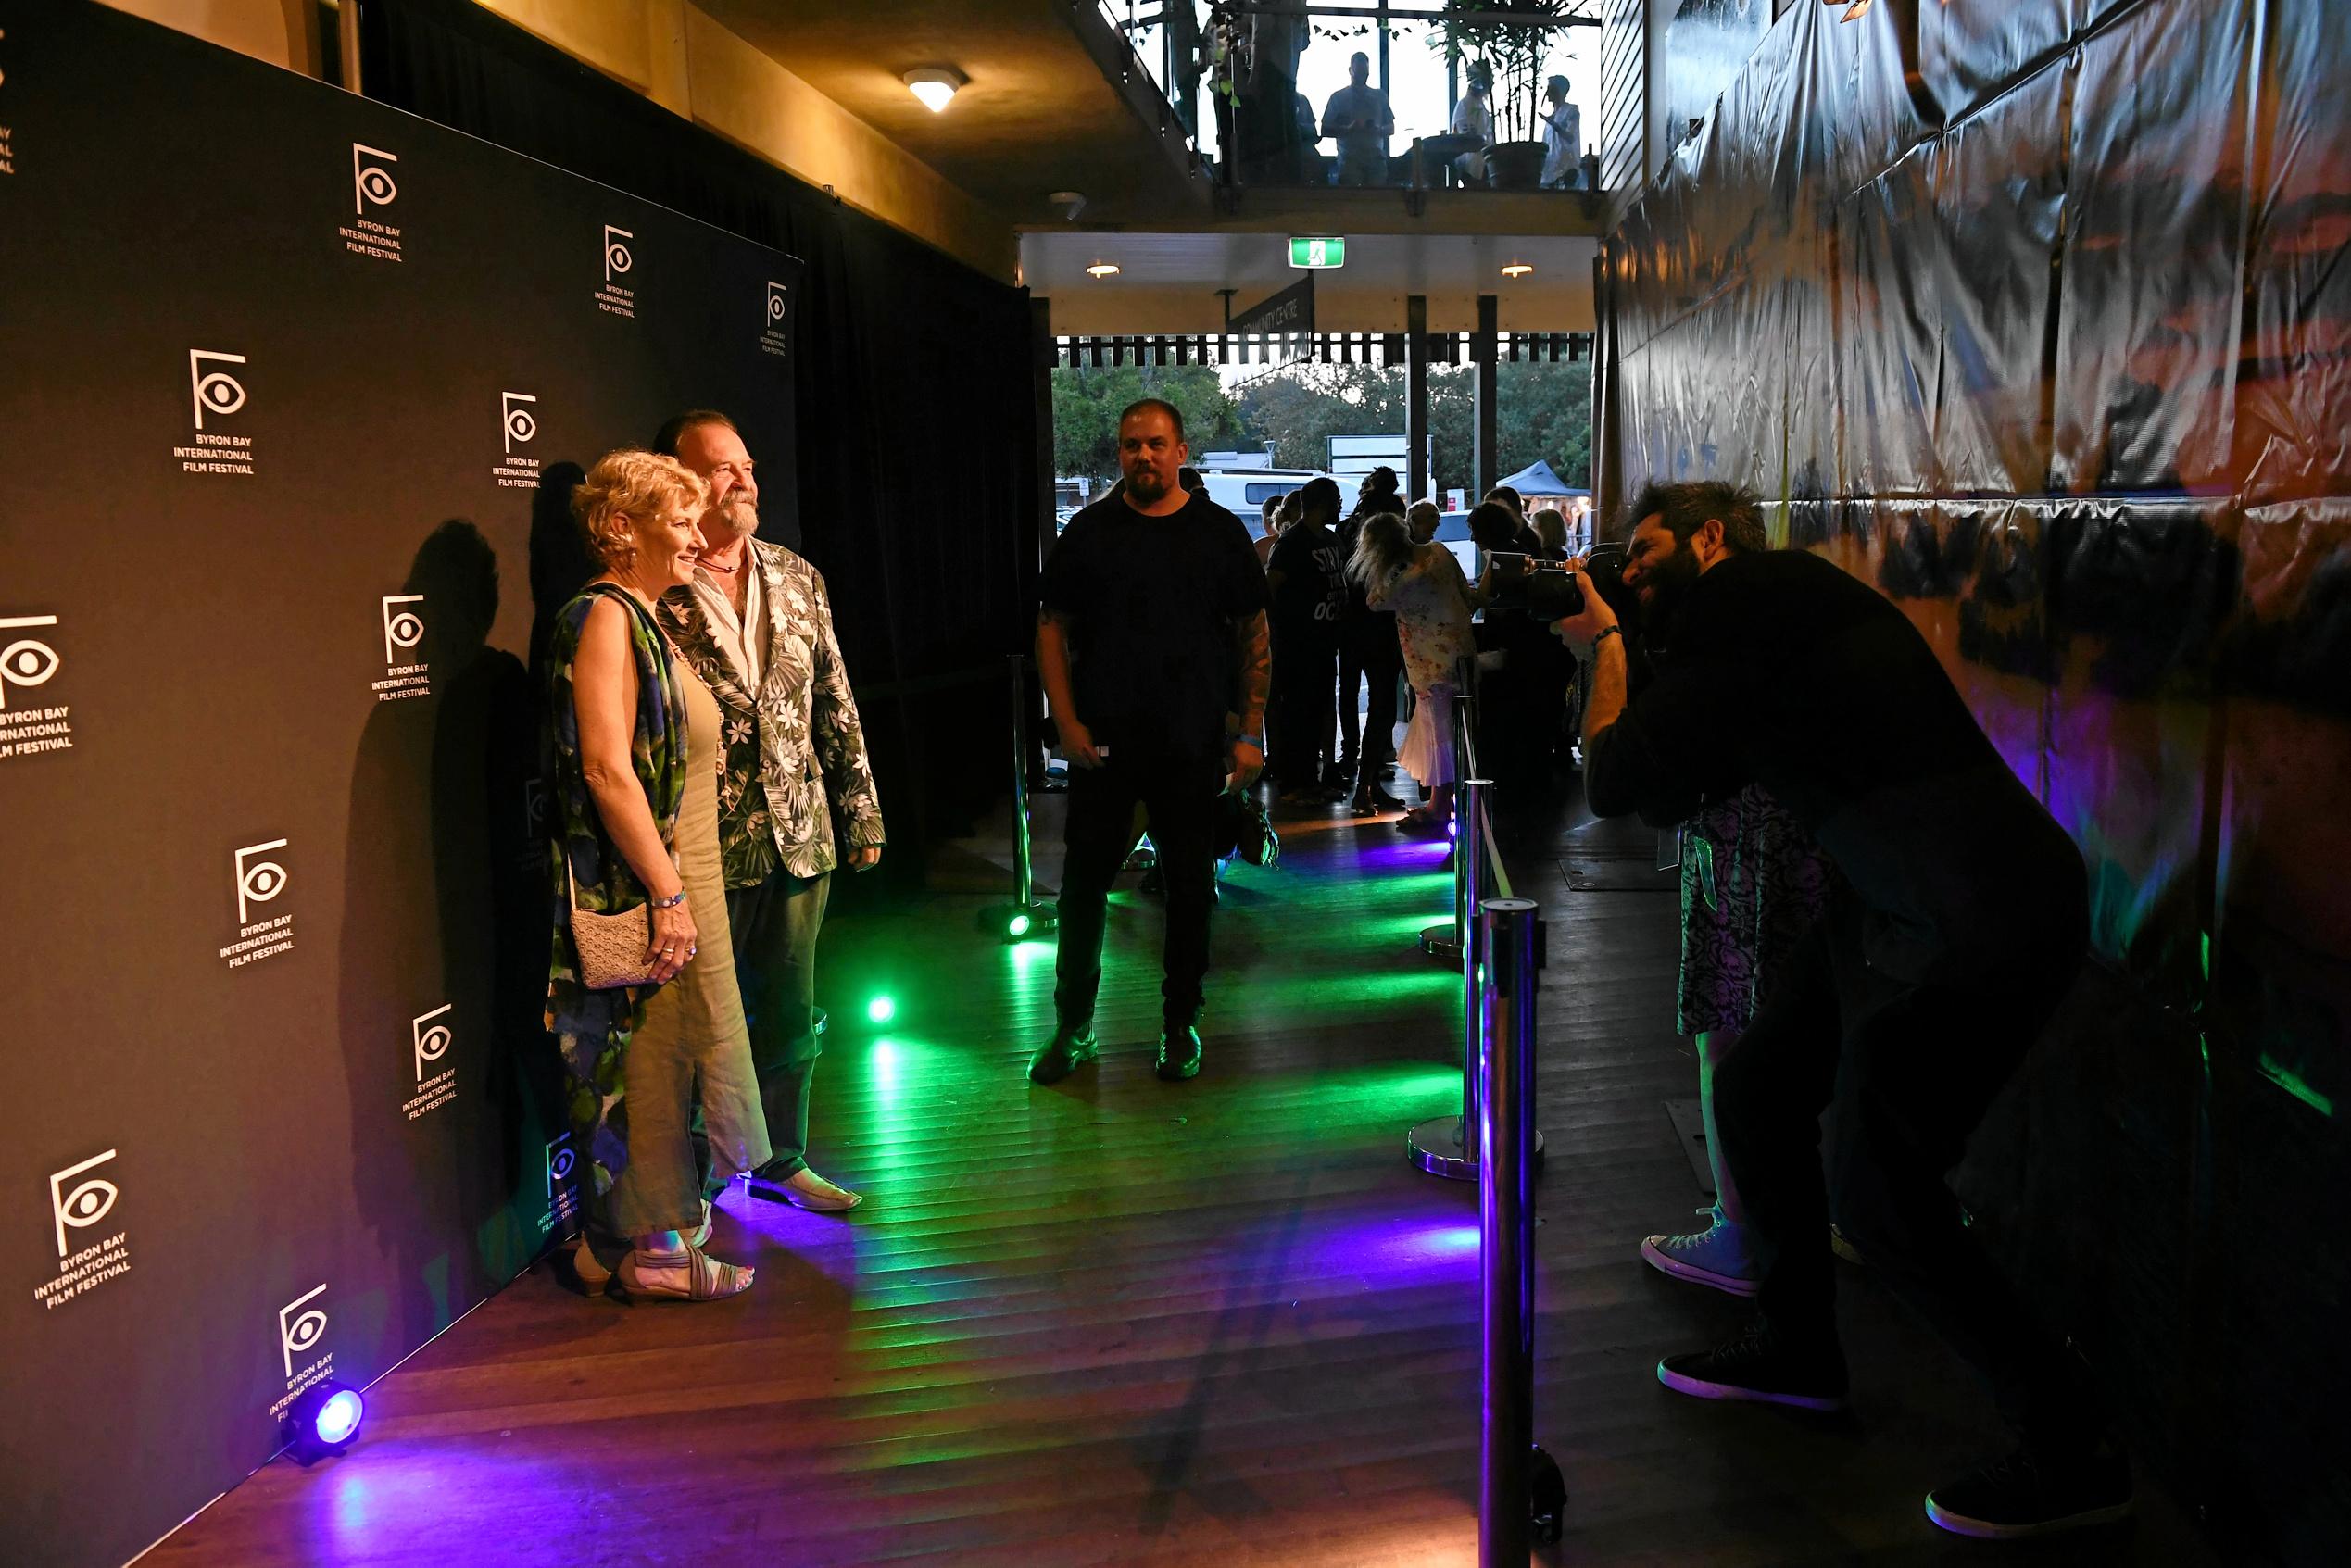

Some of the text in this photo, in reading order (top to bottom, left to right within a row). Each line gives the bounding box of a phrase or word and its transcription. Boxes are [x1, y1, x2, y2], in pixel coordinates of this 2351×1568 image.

[358, 219, 400, 236] BYRON BAY
[339, 227, 401, 250] INTERNATIONAL
[347, 241, 402, 262] FILM FESTIVAL
[594, 291, 635, 308] INTERNATIONAL
[606, 283, 634, 298] BYRON BAY
[599, 302, 635, 319] FILM FESTIVAL
[1242, 297, 1298, 342] COMMUNITY CENTRE
[196, 433, 251, 446] BYRON BAY
[173, 447, 253, 461] INTERNATIONAL
[506, 457, 540, 468] BYRON BAY
[183, 462, 255, 475] FILM FESTIVAL
[492, 467, 541, 479] INTERNATIONAL
[498, 478, 541, 489] FILM FESTIVAL
[1312, 546, 1340, 572] STAY
[387, 663, 429, 677] BYRON BAY
[371, 675, 431, 691] INTERNATIONAL
[379, 686, 431, 702] FILM FESTIVAL
[0, 706, 69, 726] BYRON BAY
[0, 721, 72, 742] RNATIONAL
[15, 737, 74, 756] FESTIVAL
[241, 914, 293, 938] BYRON BAY
[220, 927, 295, 959] INTERNATIONAL
[229, 940, 295, 969] FILM FESTIVAL
[417, 1067, 456, 1094] BYRON BAY
[402, 1079, 457, 1112] INTERNATIONAL
[409, 1090, 458, 1121] FILM FESTIVAL
[537, 1195, 579, 1227] INTERNATIONAL
[542, 1220, 555, 1234] FILM
[60, 1232, 126, 1273] BYRON BAY
[34, 1247, 130, 1300] INTERNATIONAL
[46, 1261, 132, 1310] FILM FESTIVAL
[286, 1352, 333, 1390] BYRON BAY
[269, 1365, 334, 1416] INTERNATIONAL
